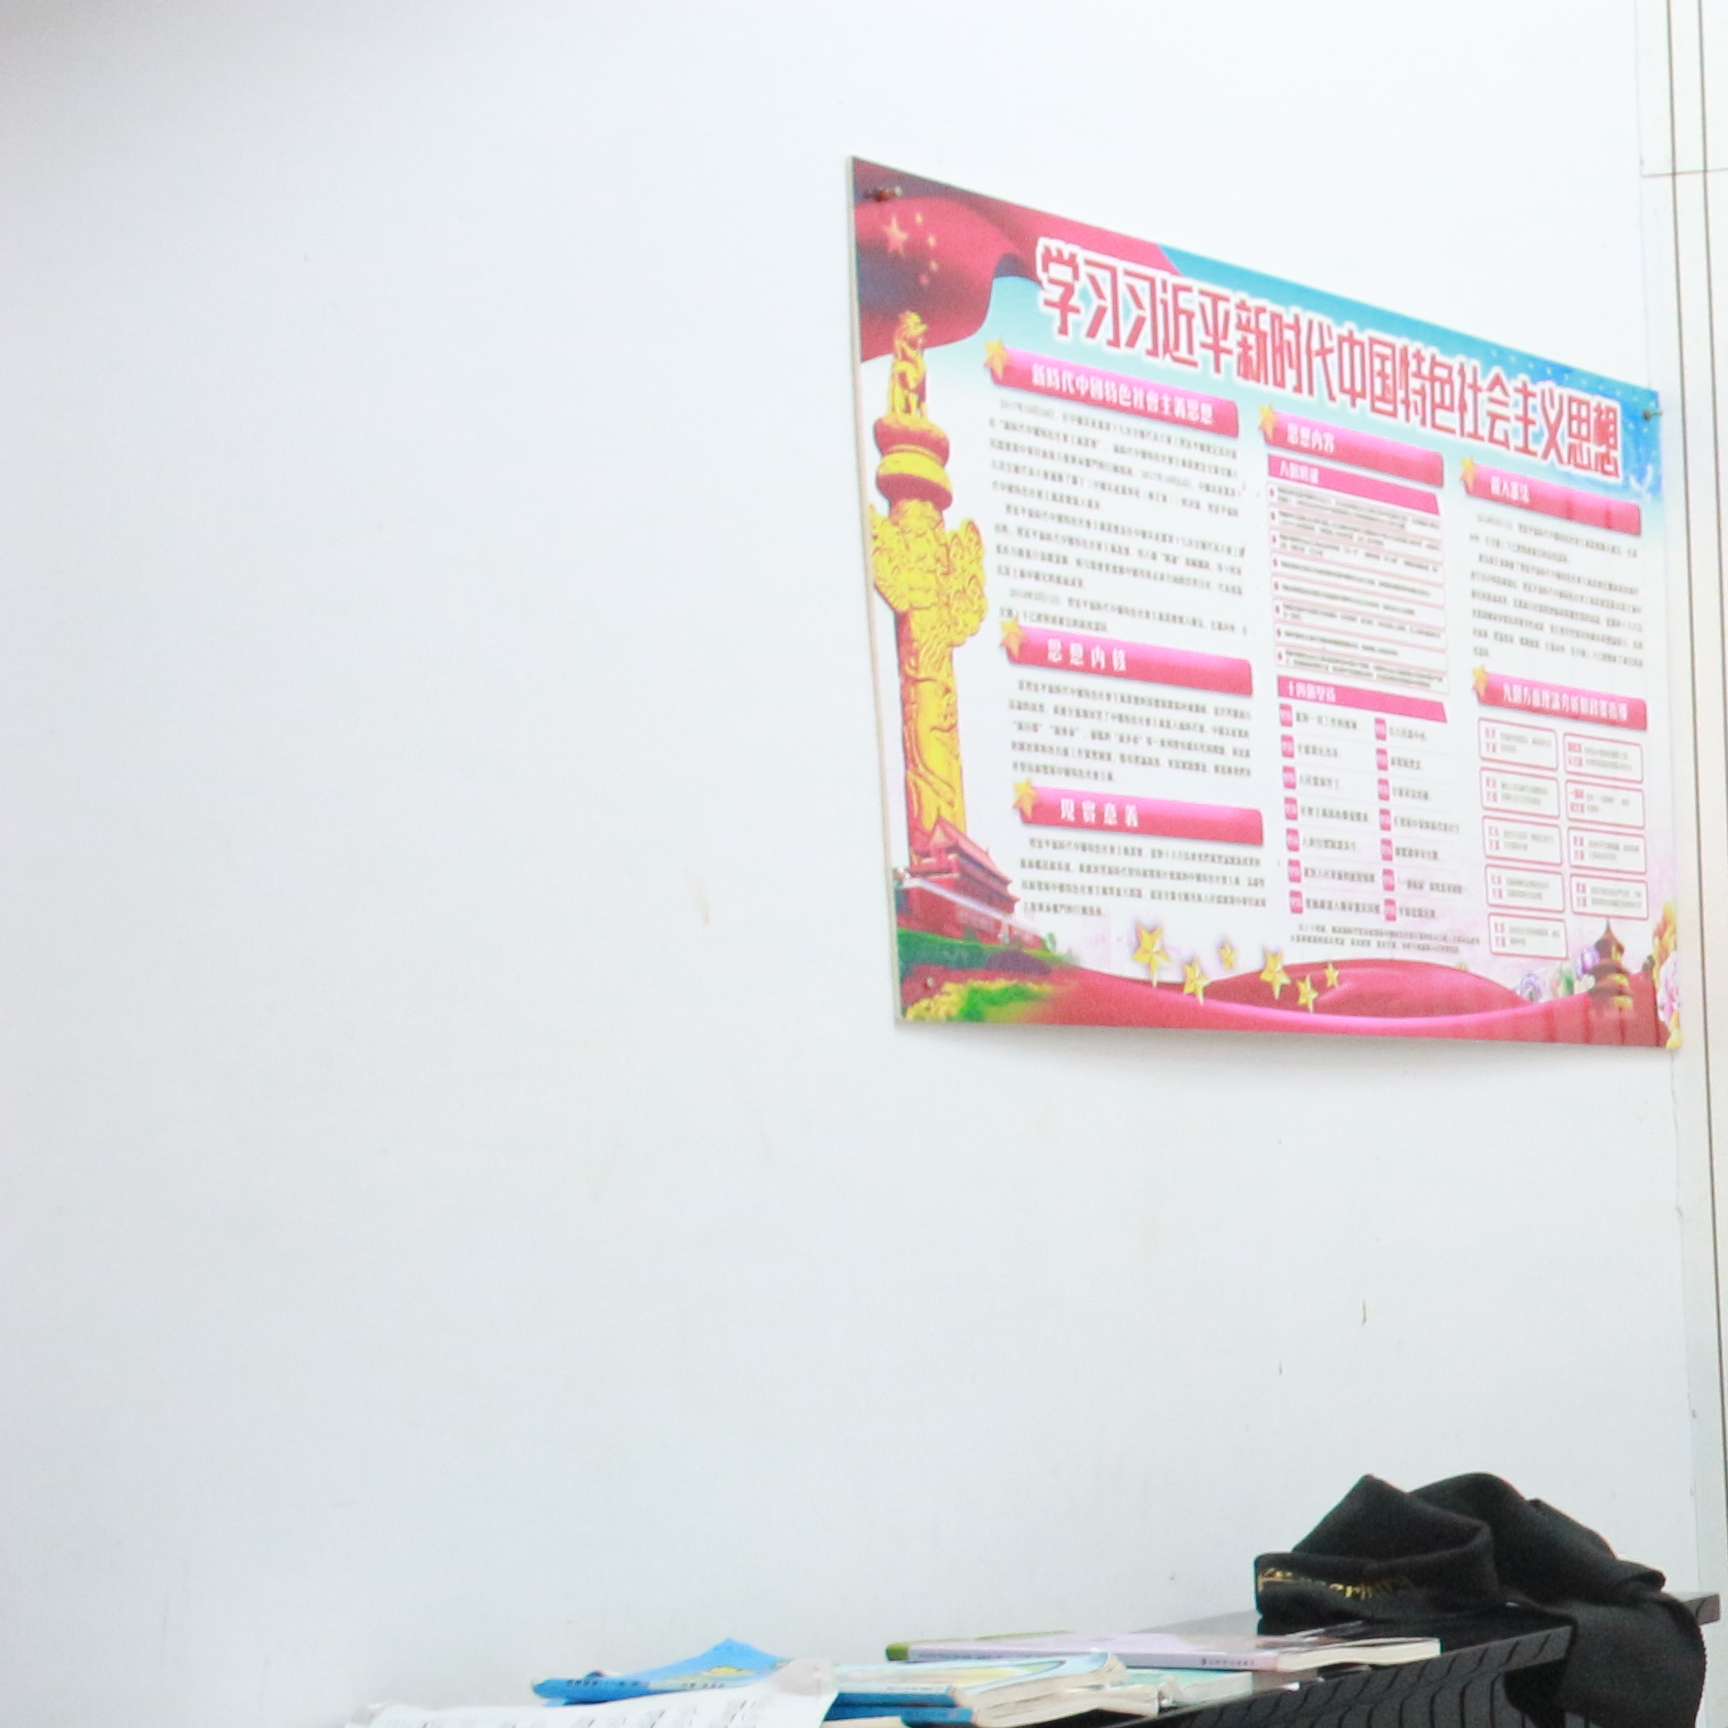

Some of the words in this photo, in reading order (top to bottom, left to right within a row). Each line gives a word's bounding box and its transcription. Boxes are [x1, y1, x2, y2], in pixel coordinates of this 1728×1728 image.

[1041, 245, 1620, 478] 学习习近平新时代中国特色社会主义思想
